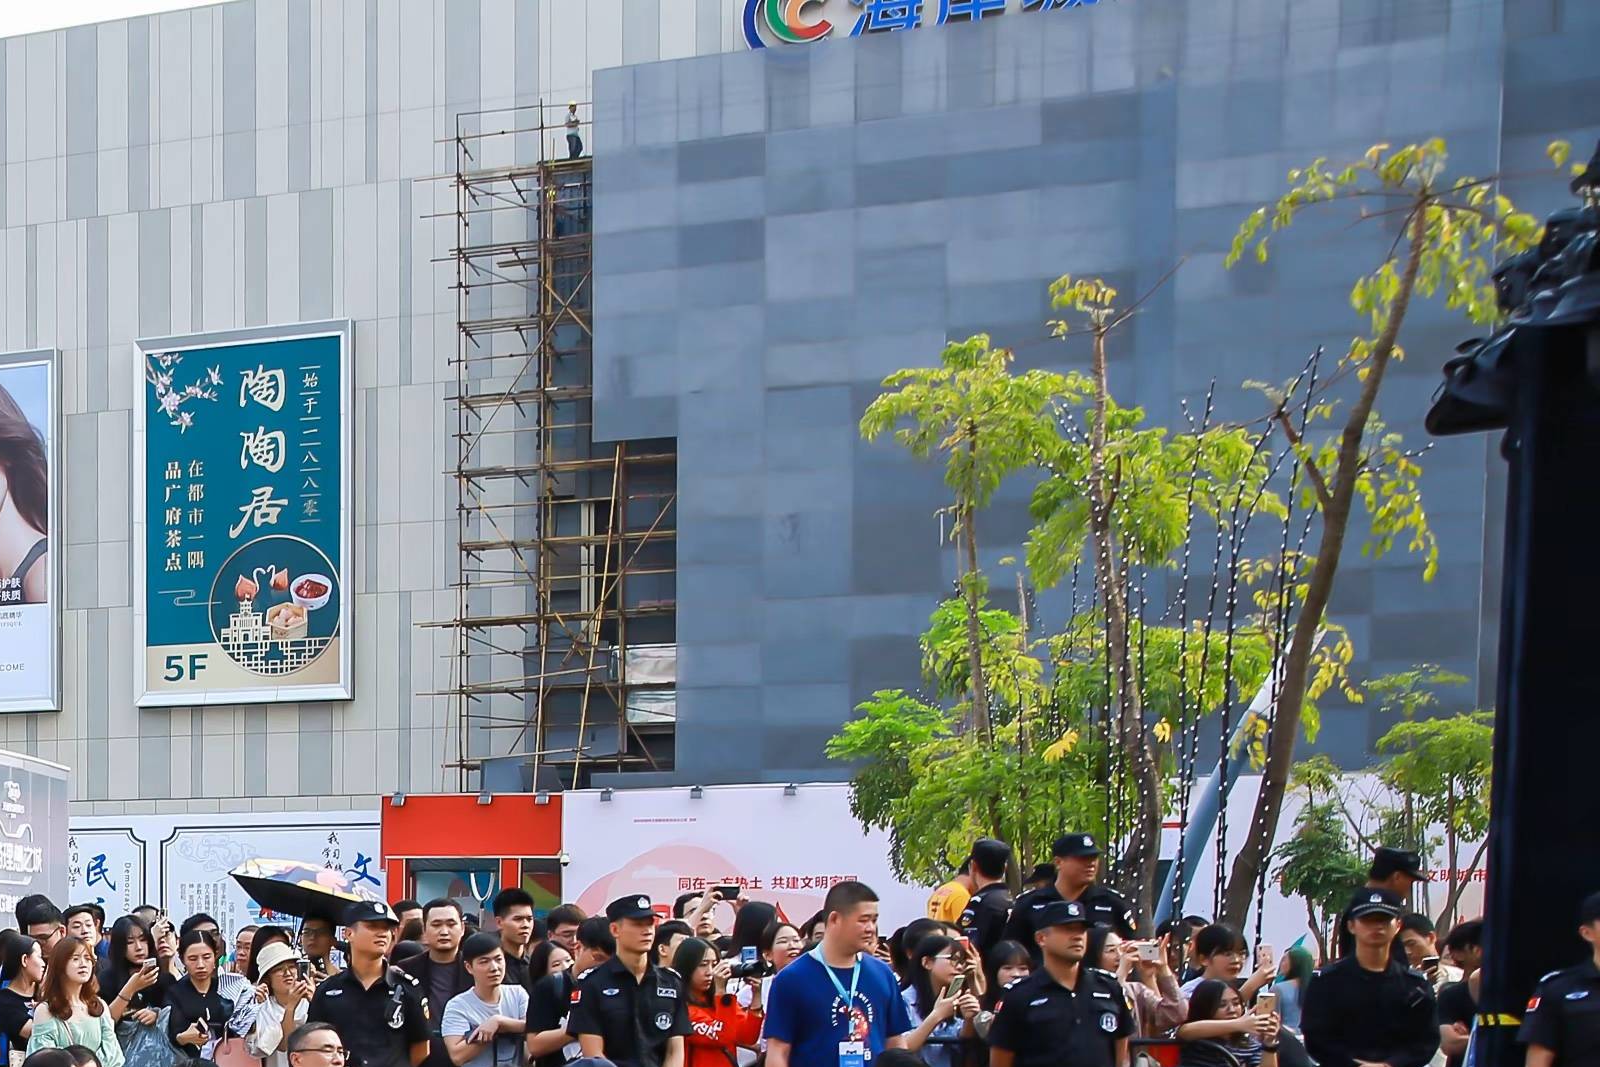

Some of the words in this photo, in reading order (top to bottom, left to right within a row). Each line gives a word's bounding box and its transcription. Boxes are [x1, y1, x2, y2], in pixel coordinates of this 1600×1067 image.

[229, 363, 289, 539] 陶陶居
[164, 460, 182, 572] 品广府茶点
[187, 459, 205, 569] 在都市一隅
[163, 652, 209, 683] 5F
[86, 853, 117, 903] 民
[123, 862, 132, 913] Democracy
[344, 852, 381, 887] 文
